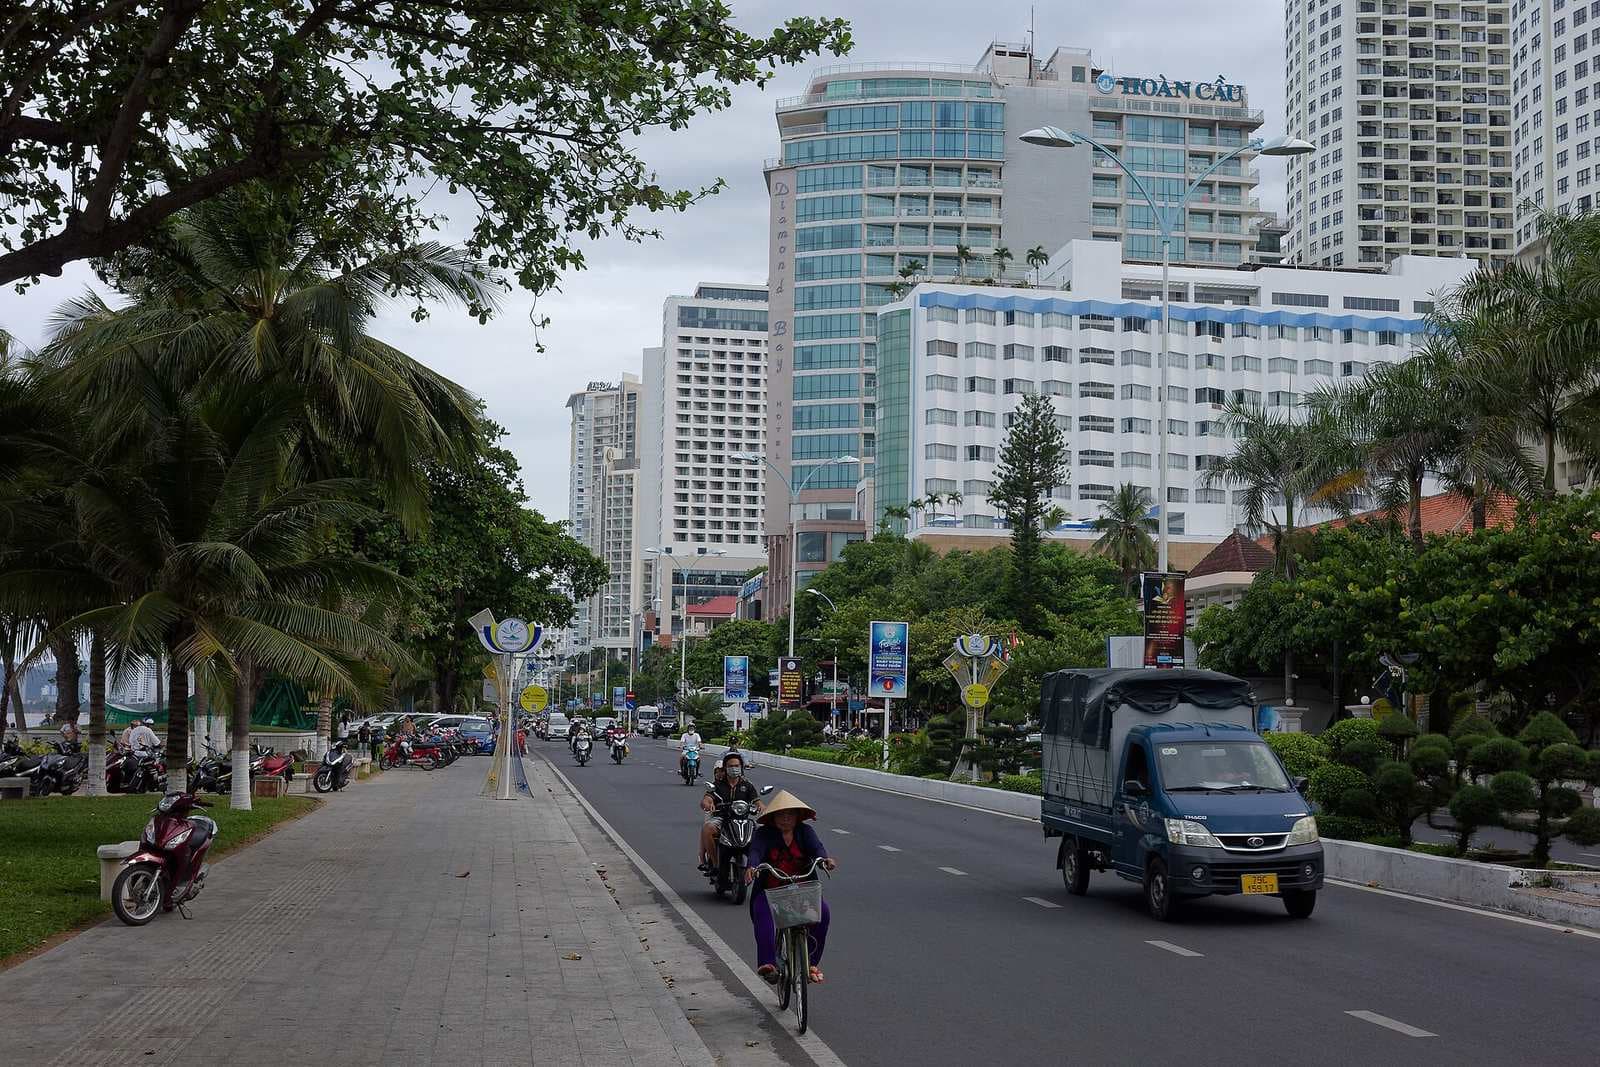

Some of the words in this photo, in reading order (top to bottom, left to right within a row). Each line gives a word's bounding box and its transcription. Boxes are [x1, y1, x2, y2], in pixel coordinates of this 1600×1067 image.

[1121, 74, 1191, 98] HOÀN
[1195, 74, 1243, 102] CẦU
[774, 182, 790, 294] Diamond
[773, 321, 788, 374] Bay
[775, 401, 783, 460] HOTEL
